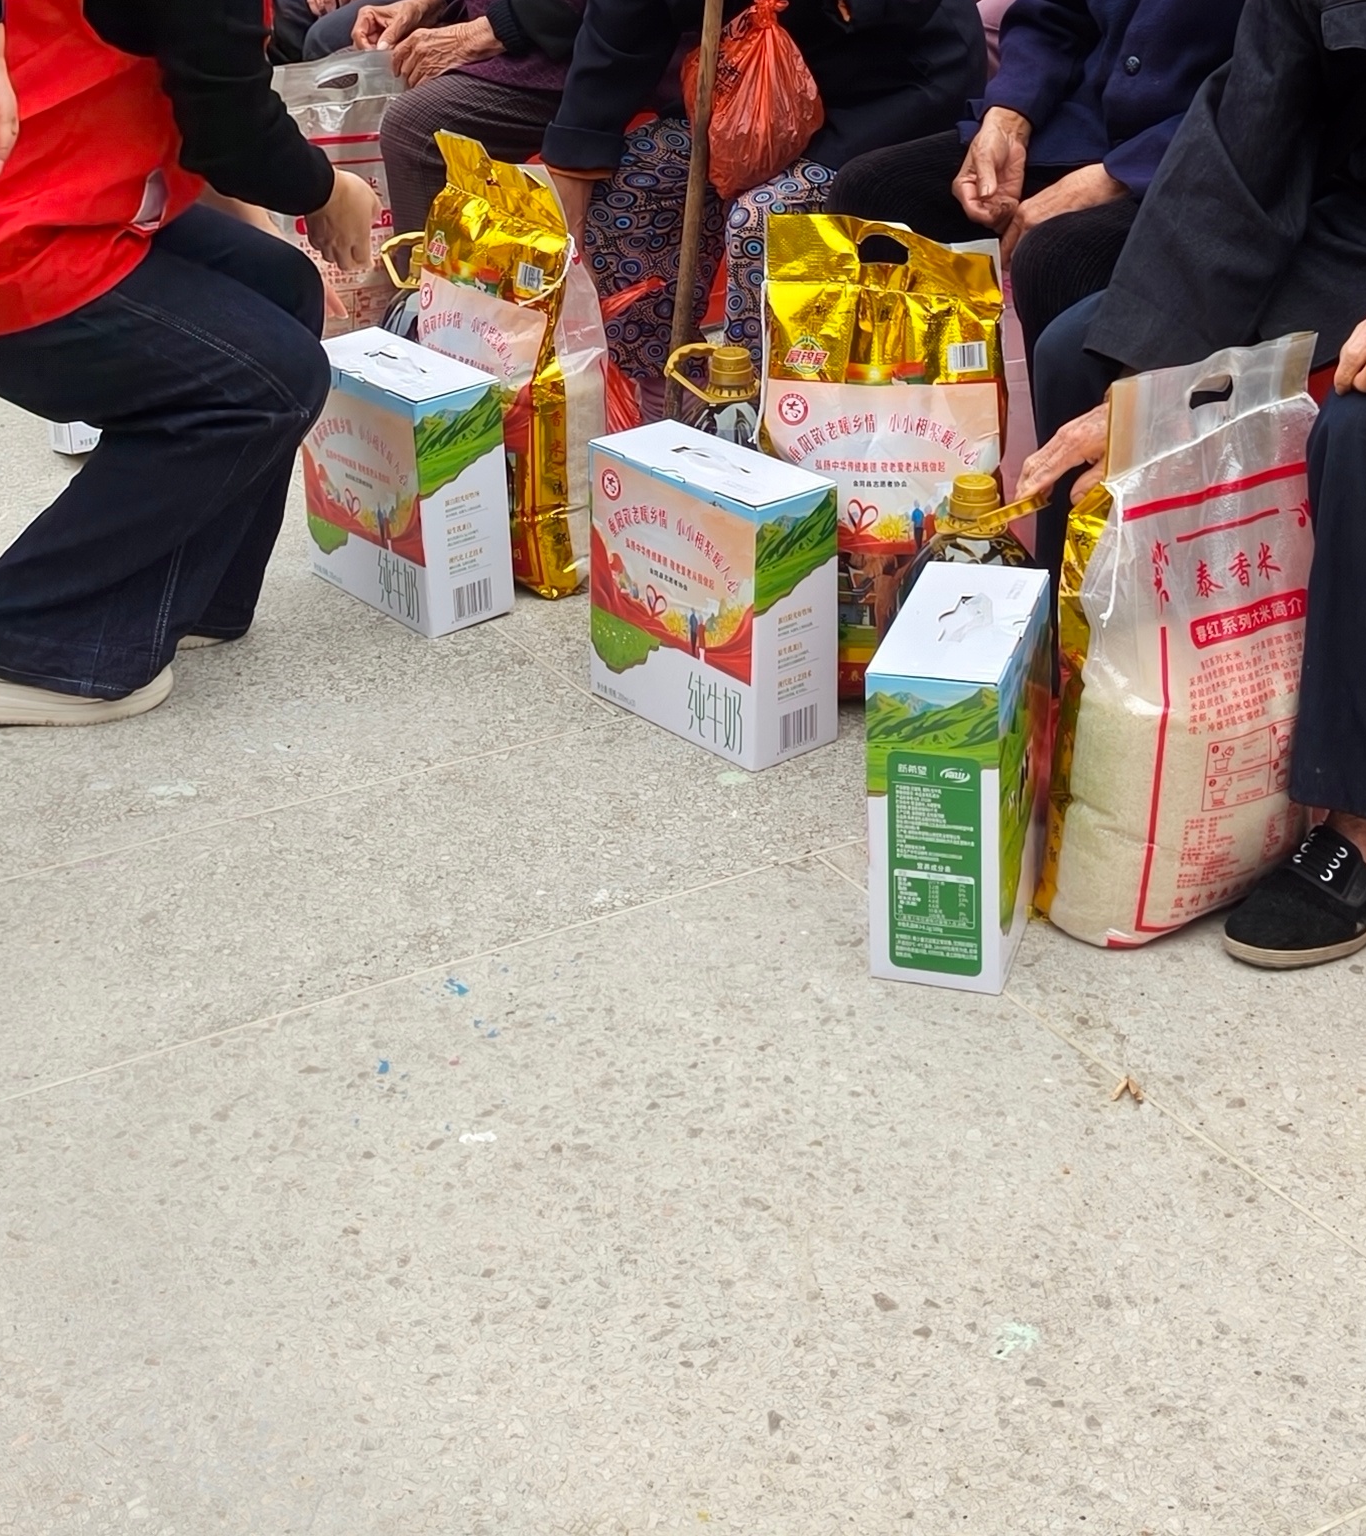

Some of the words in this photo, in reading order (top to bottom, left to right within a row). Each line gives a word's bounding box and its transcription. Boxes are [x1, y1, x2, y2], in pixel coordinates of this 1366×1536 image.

[788, 413, 877, 464] 重阳敬老暖乡情
[888, 413, 981, 466] 小小相聚暖人心
[880, 460, 946, 473] 敬老爱老从我做起
[1195, 542, 1283, 599] 泰香米
[688, 670, 743, 755] 纯牛奶
